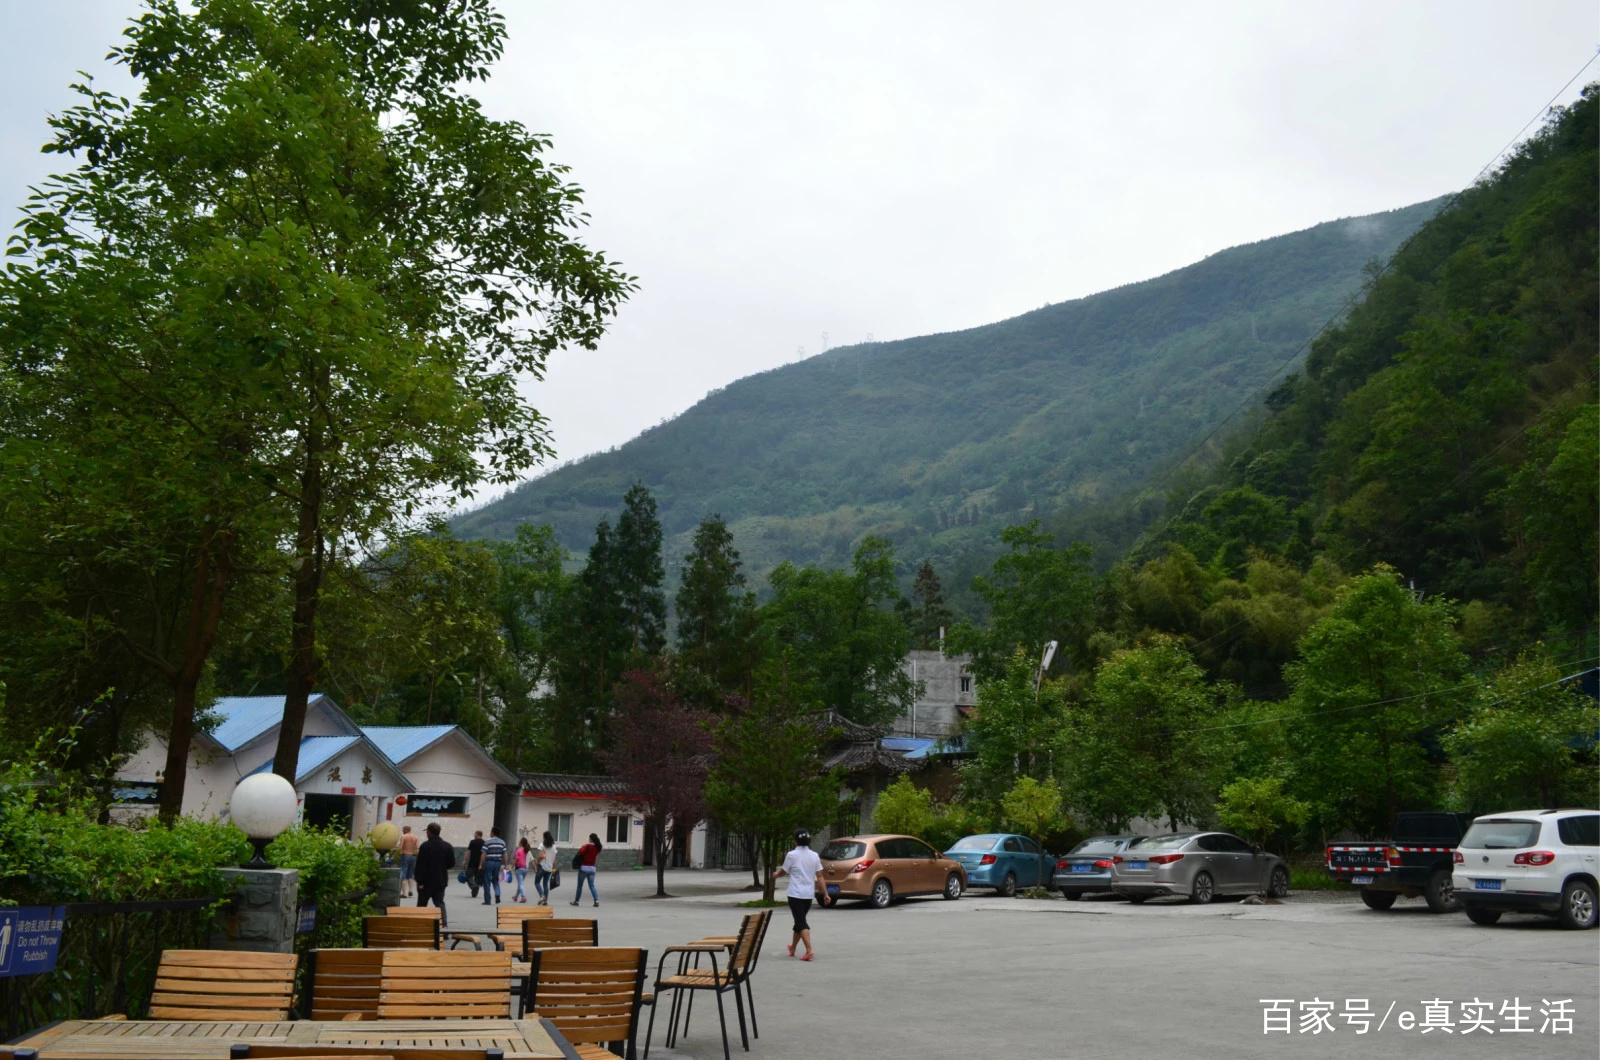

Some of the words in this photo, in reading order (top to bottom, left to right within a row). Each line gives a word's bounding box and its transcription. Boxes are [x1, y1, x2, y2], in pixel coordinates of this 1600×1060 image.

[18, 937, 27, 947] Do
[29, 937, 39, 946] not
[40, 935, 57, 945] Throw
[24, 951, 47, 961] Rubbish
